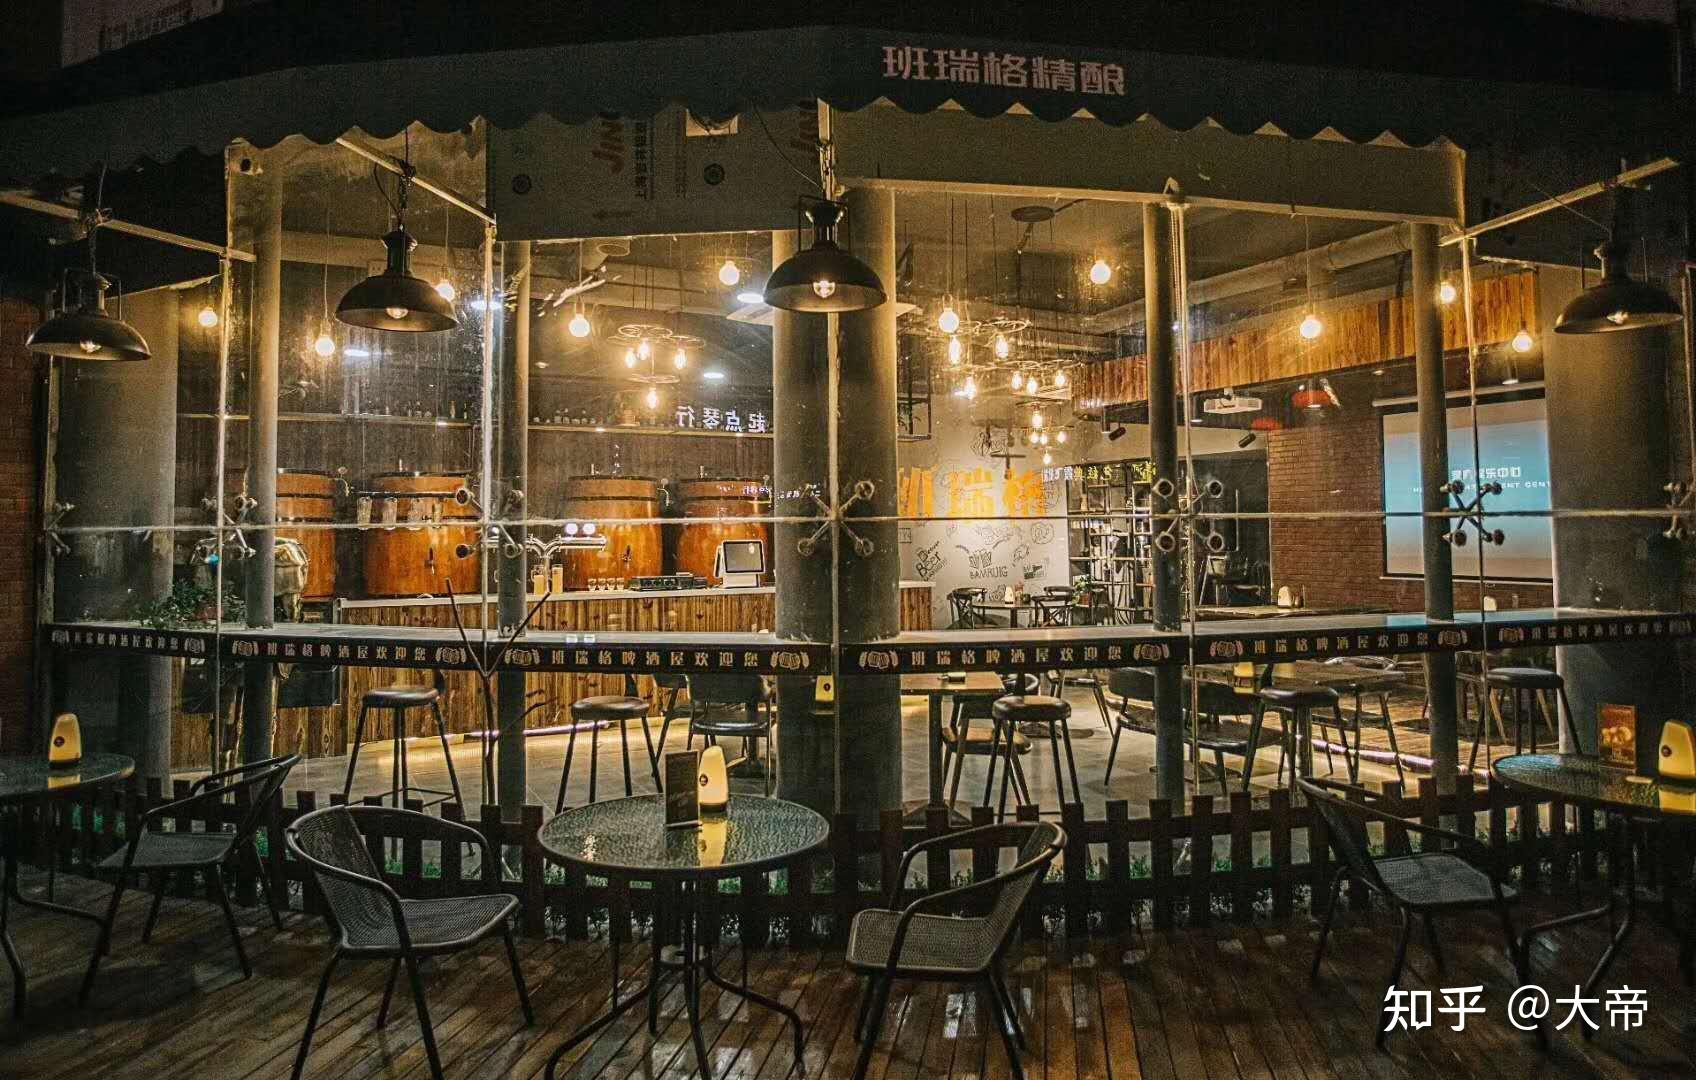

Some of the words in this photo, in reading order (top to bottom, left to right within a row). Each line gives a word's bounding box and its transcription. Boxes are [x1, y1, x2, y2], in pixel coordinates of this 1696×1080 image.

[882, 45, 1127, 96] 班瑞格精酿
[266, 641, 427, 663] 班瑞格啤酒屋欢迎您
[550, 648, 758, 668] 班瑞格啤酒屋欢迎您
[911, 647, 1122, 666] 班瑞格啤酒屋欢迎您
